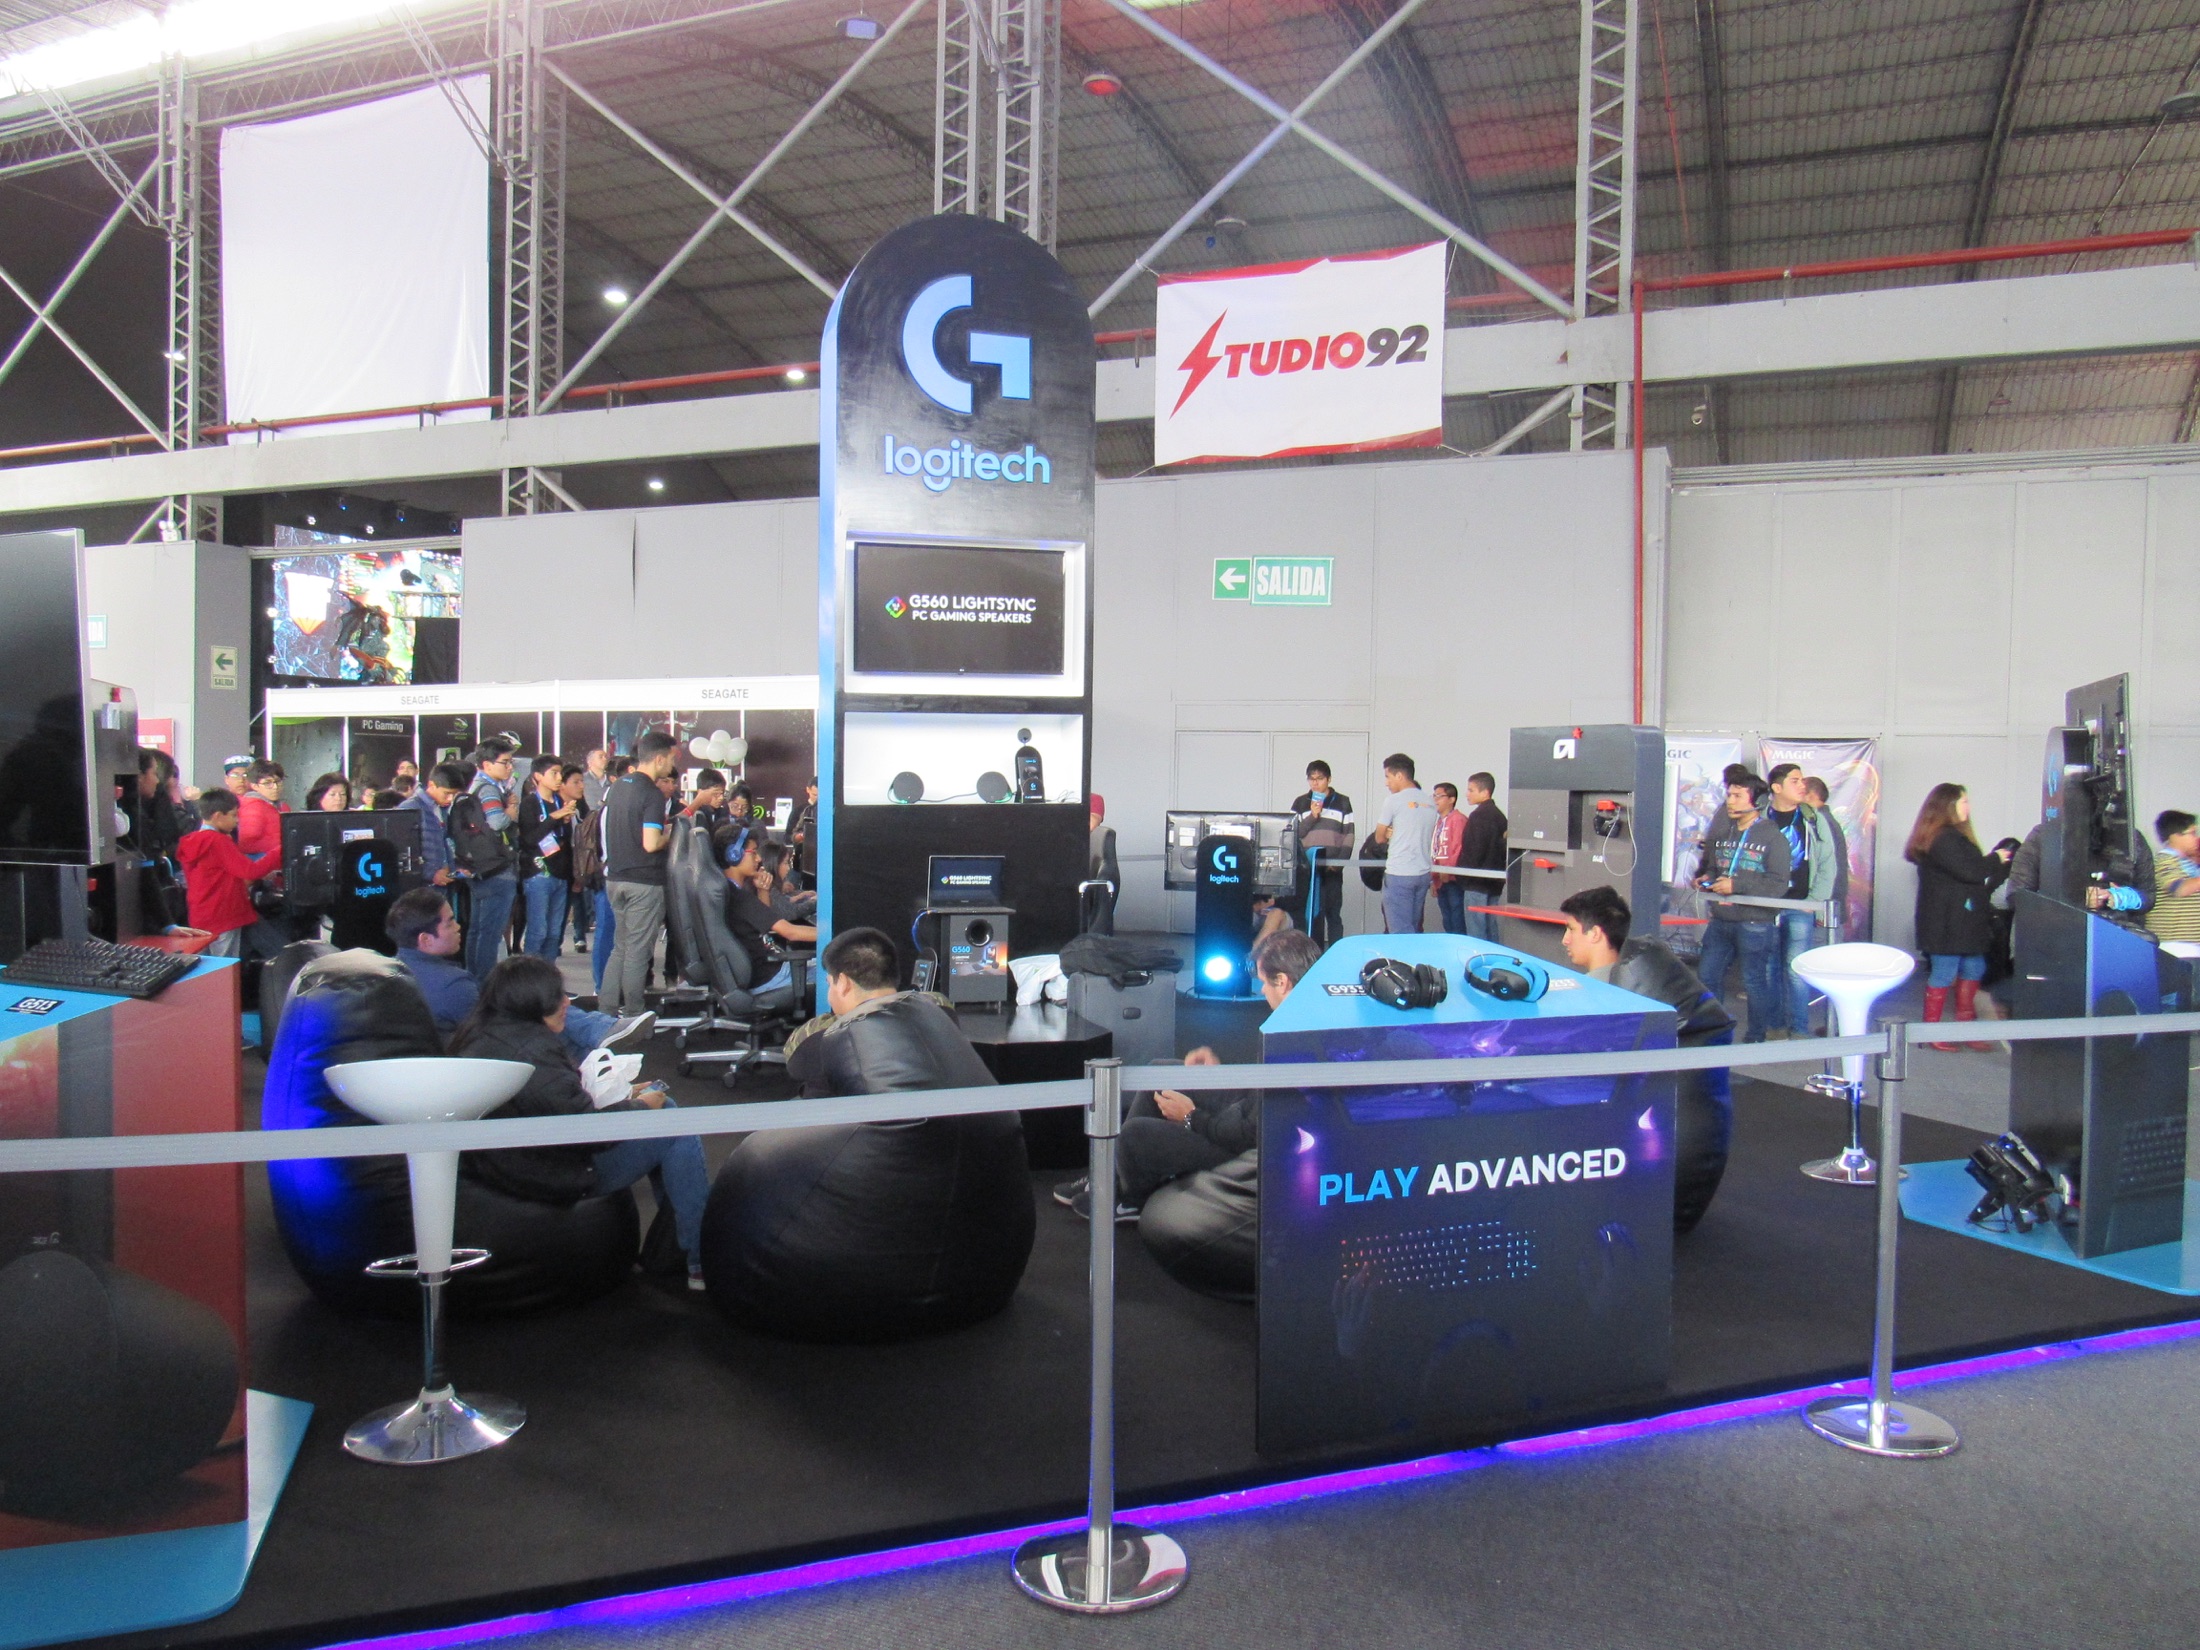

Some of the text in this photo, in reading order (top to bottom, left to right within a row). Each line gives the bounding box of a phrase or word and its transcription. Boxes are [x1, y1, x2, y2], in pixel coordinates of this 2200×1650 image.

[884, 434, 1051, 492] logitech
[1256, 565, 1326, 596] SALIDA
[909, 594, 1037, 612] G560 LIGHTSYNC
[912, 610, 1032, 624] PC GAMING SPEAKERS
[401, 695, 440, 705] SEAGATE
[701, 688, 749, 699] SEAGATE
[362, 719, 404, 733] PC Gaming
[1666, 749, 1692, 760] GIC
[1772, 750, 1815, 760] MAGIC
[1209, 873, 1239, 885] logitech
[355, 885, 385, 898] logitech
[951, 945, 971, 954] G560
[19, 998, 58, 1011] G513
[1319, 1147, 1626, 1206] PLAY ADVANCED
